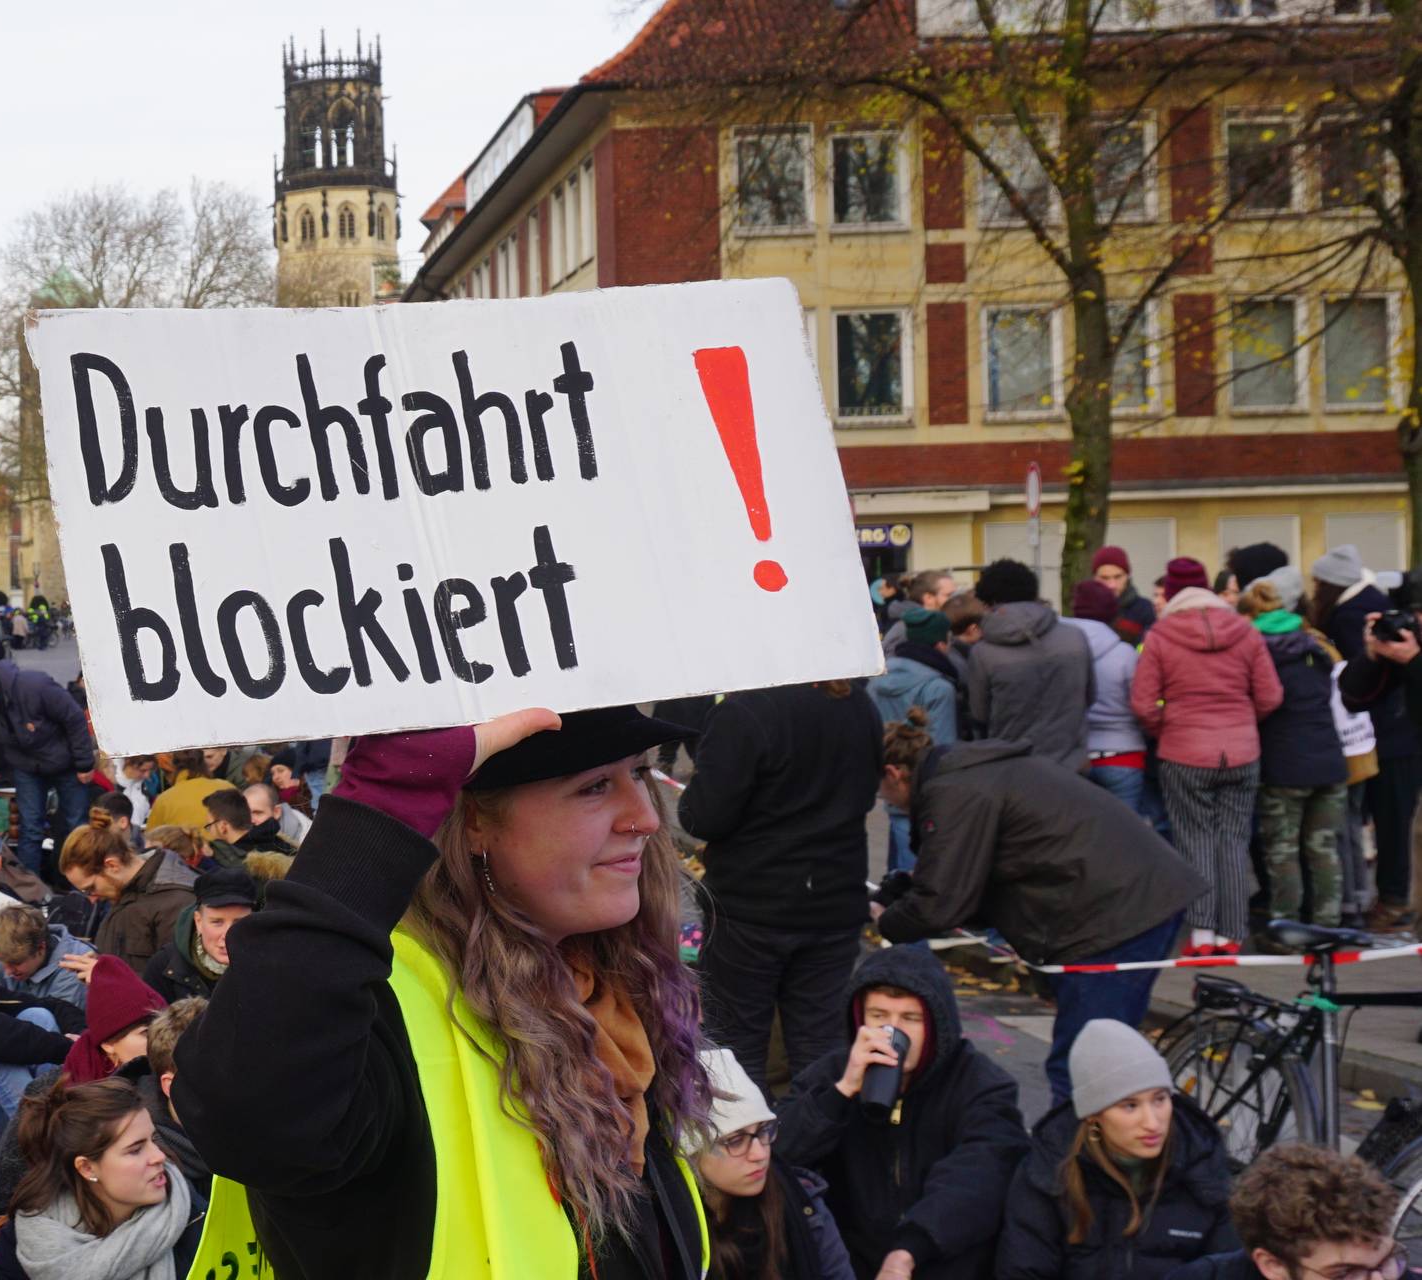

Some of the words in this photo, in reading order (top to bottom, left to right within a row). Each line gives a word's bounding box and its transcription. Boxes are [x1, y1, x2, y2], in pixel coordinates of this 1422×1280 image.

[70, 341, 600, 510] Durchfahrt
[693, 345, 790, 592] !
[100, 525, 577, 702] blockiert
